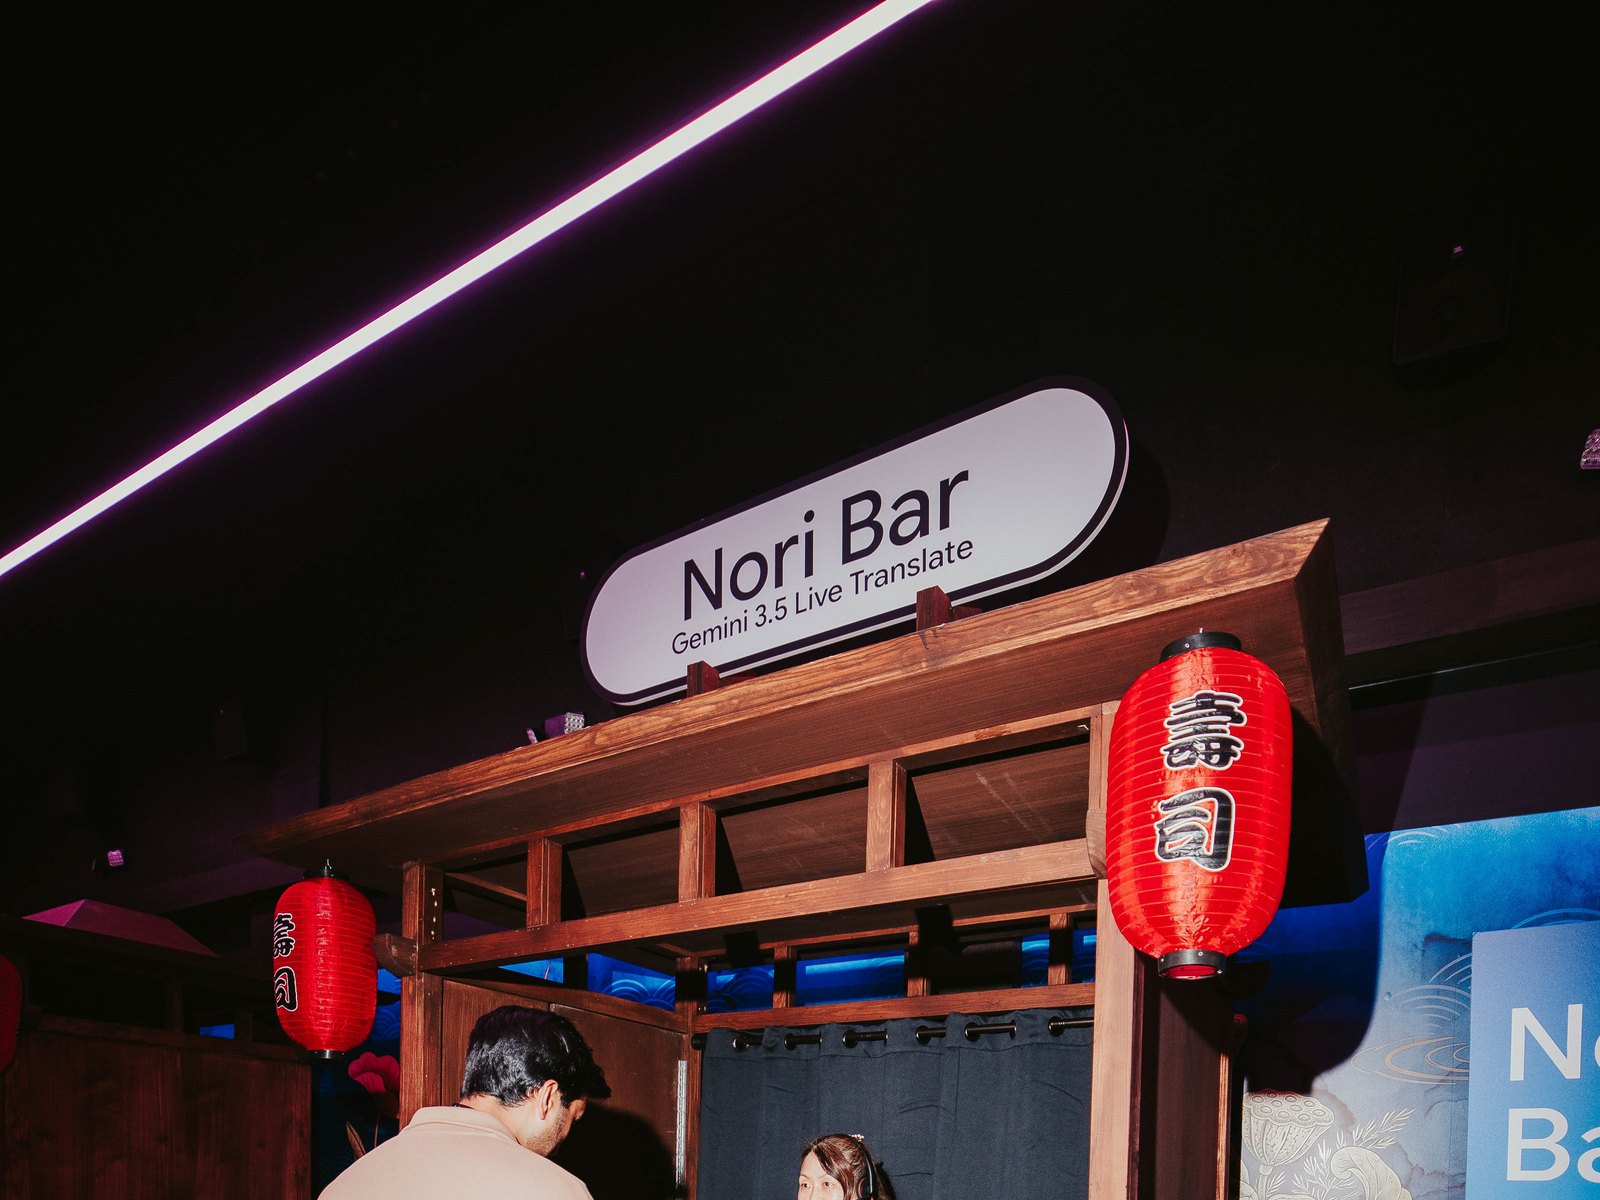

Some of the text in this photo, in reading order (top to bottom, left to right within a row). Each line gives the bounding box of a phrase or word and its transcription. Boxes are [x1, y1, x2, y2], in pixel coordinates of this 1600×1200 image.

[671, 539, 974, 654] Gemini 3.5 Live Translate
[684, 469, 969, 621] Nori Bar
[1510, 1003, 1600, 1082] N
